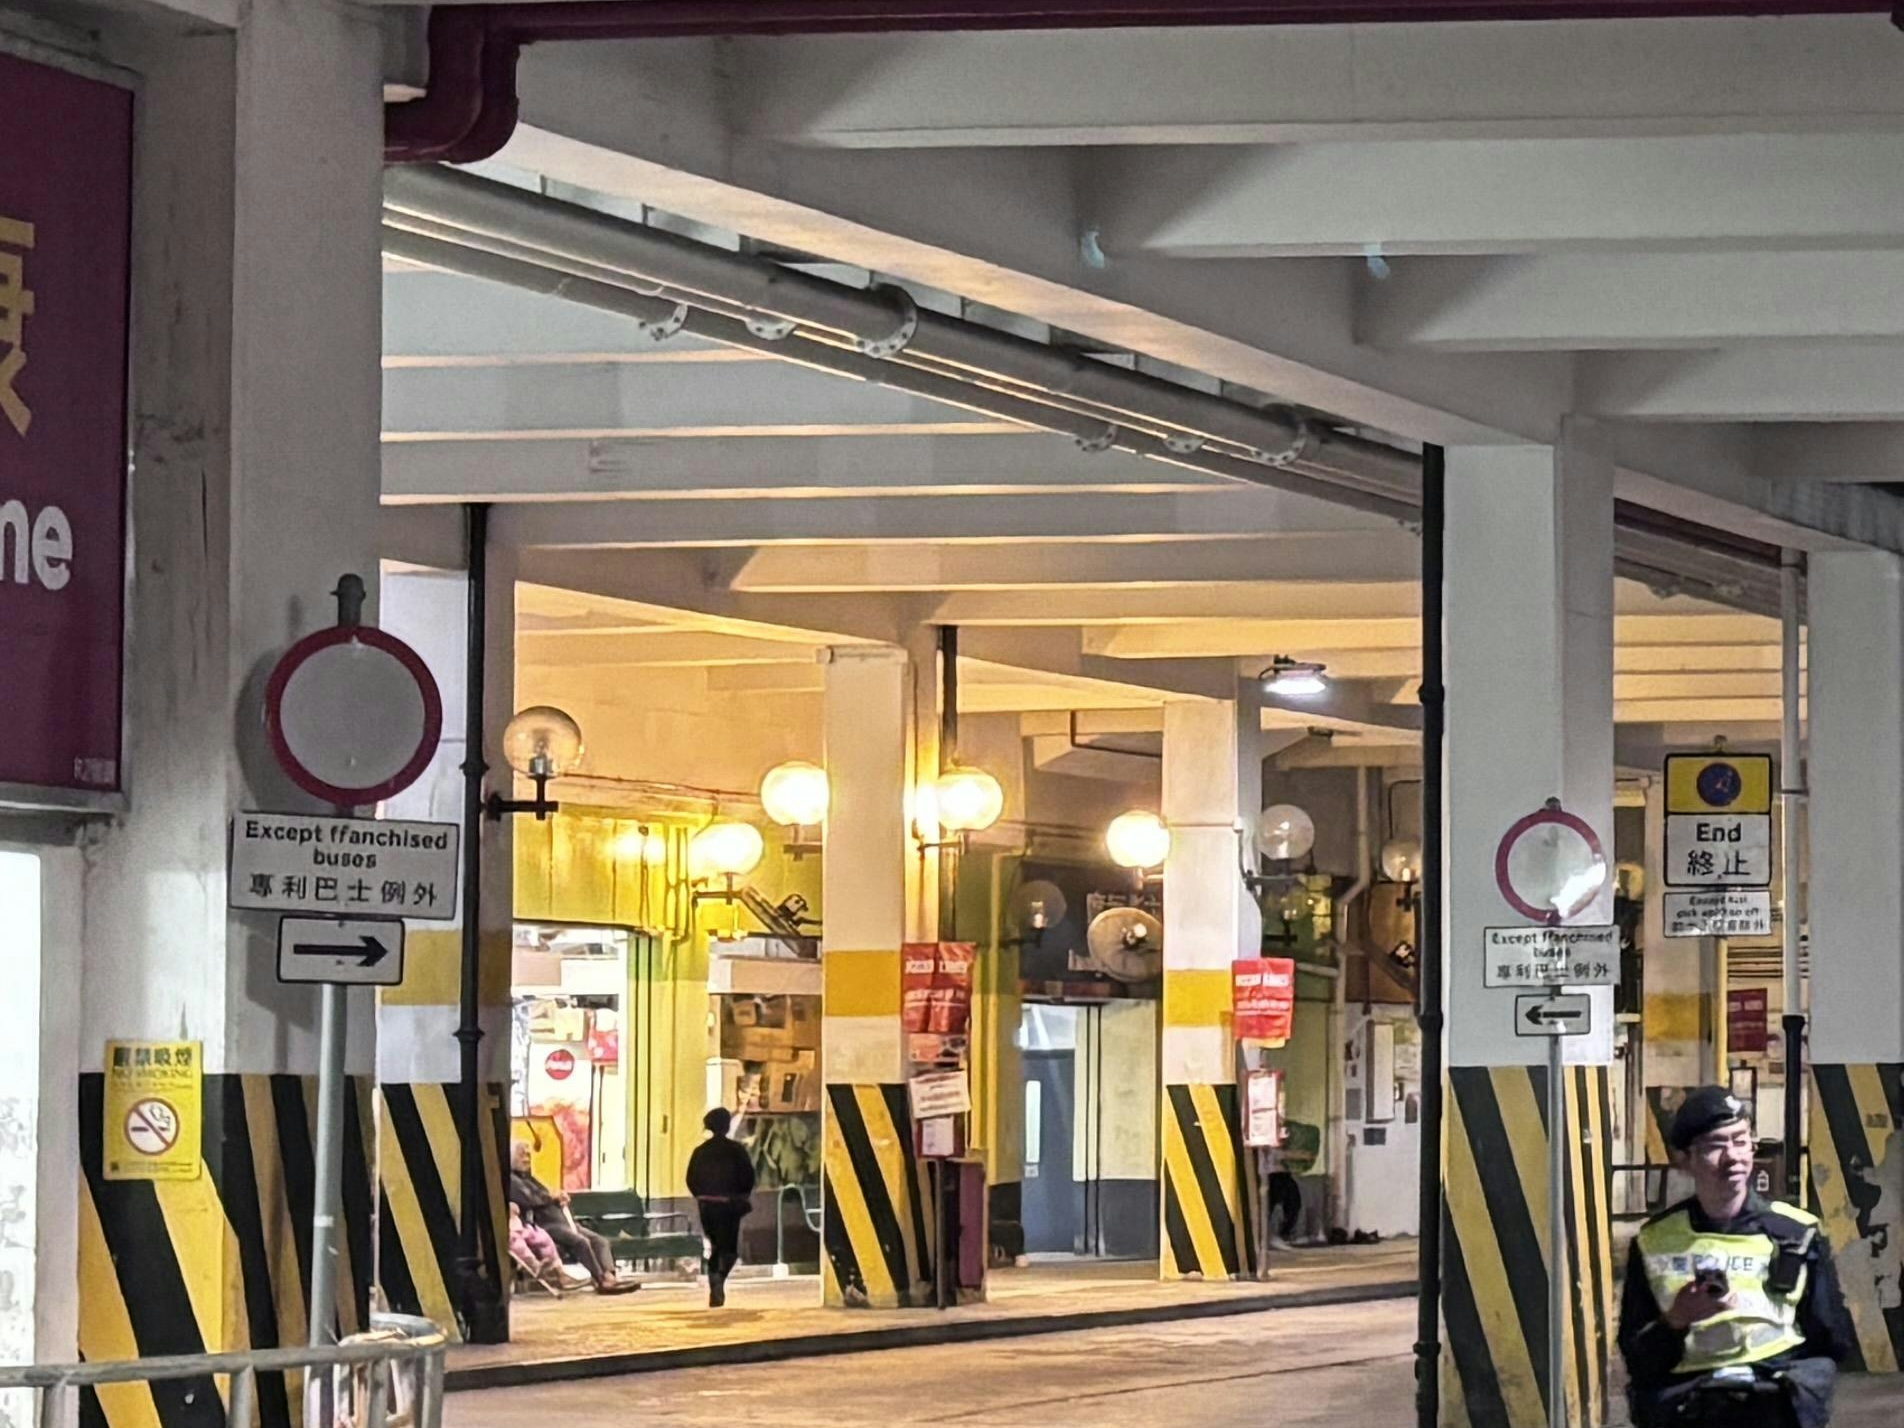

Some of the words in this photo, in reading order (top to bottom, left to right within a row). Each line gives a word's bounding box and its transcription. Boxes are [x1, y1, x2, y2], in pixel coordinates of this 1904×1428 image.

[245, 819, 324, 845] Except
[1696, 822, 1742, 843] End
[312, 848, 378, 869] buses
[1687, 850, 1752, 876] 終止
[249, 873, 438, 907] 專利巴士例外
